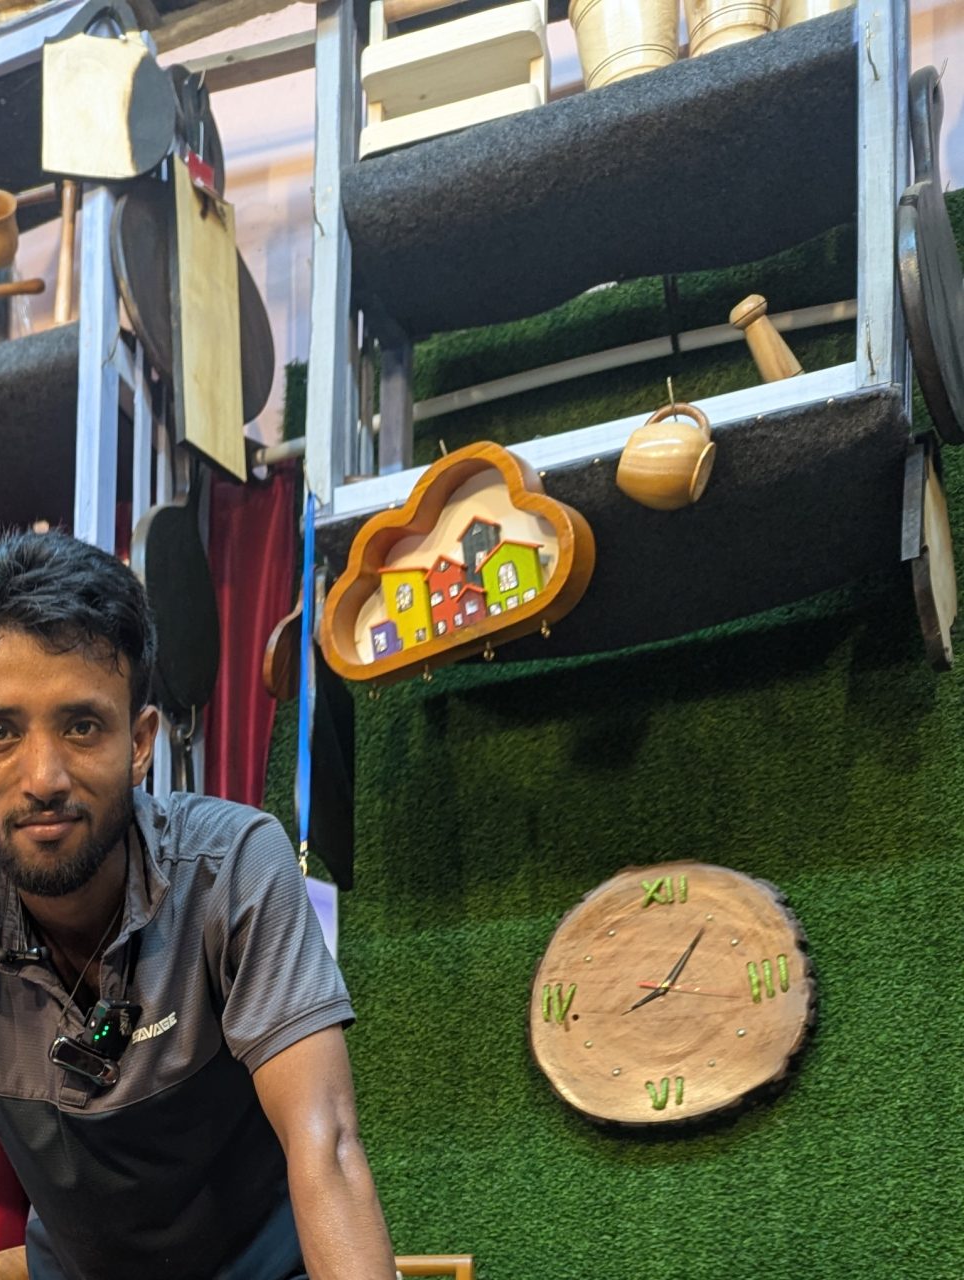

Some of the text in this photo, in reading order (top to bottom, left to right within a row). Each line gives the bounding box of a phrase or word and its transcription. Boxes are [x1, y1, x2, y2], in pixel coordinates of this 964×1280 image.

[641, 875, 688, 908] XII
[132, 1011, 177, 1044] SAVAGE
[645, 1076, 684, 1110] VI
